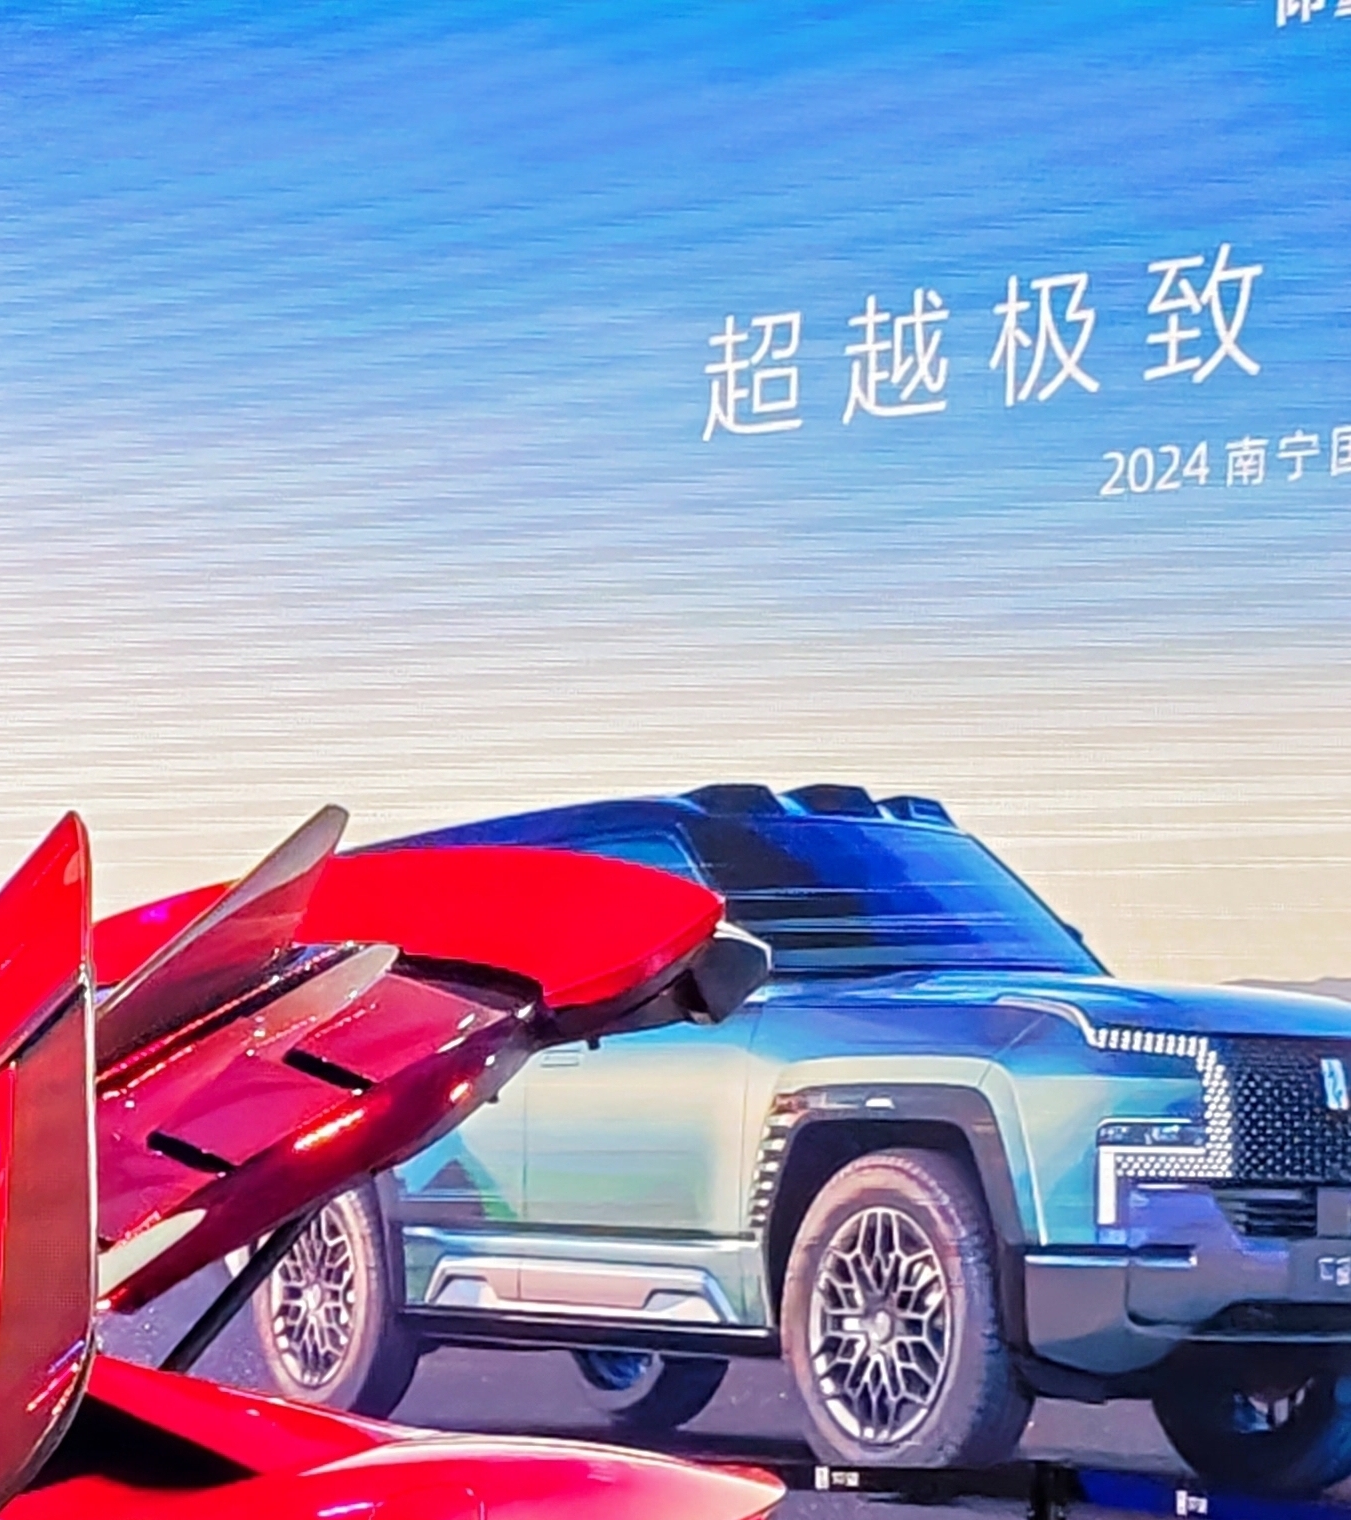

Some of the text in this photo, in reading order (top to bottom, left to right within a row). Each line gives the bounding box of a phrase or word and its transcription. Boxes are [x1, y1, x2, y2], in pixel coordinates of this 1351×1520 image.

[702, 243, 1263, 441] 超越极致
[1100, 441, 1209, 495] 2024
